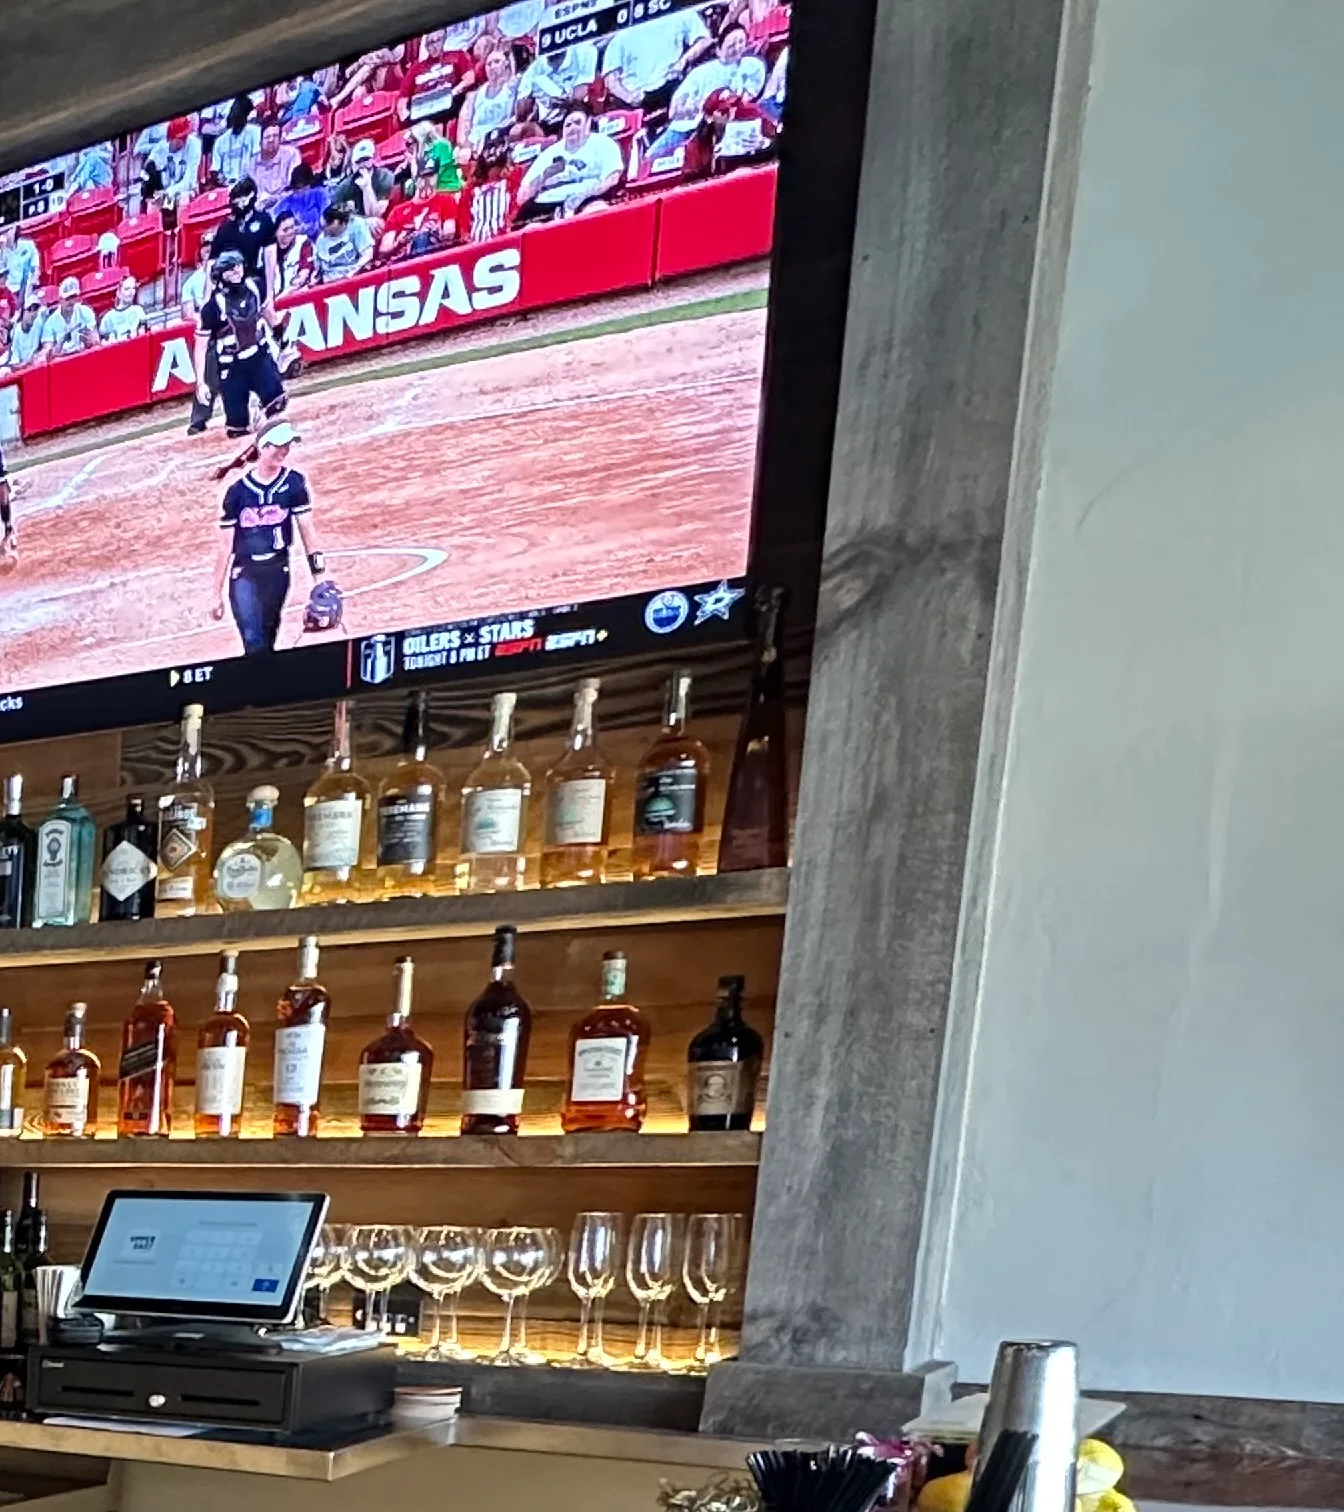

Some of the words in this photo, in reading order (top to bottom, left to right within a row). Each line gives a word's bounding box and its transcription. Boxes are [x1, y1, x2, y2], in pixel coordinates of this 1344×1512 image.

[554, 19, 599, 44] UCLA
[151, 247, 522, 394] AANSAS
[402, 630, 461, 655] OILERS
[478, 619, 536, 644] STARS
[194, 666, 214, 683] ET
